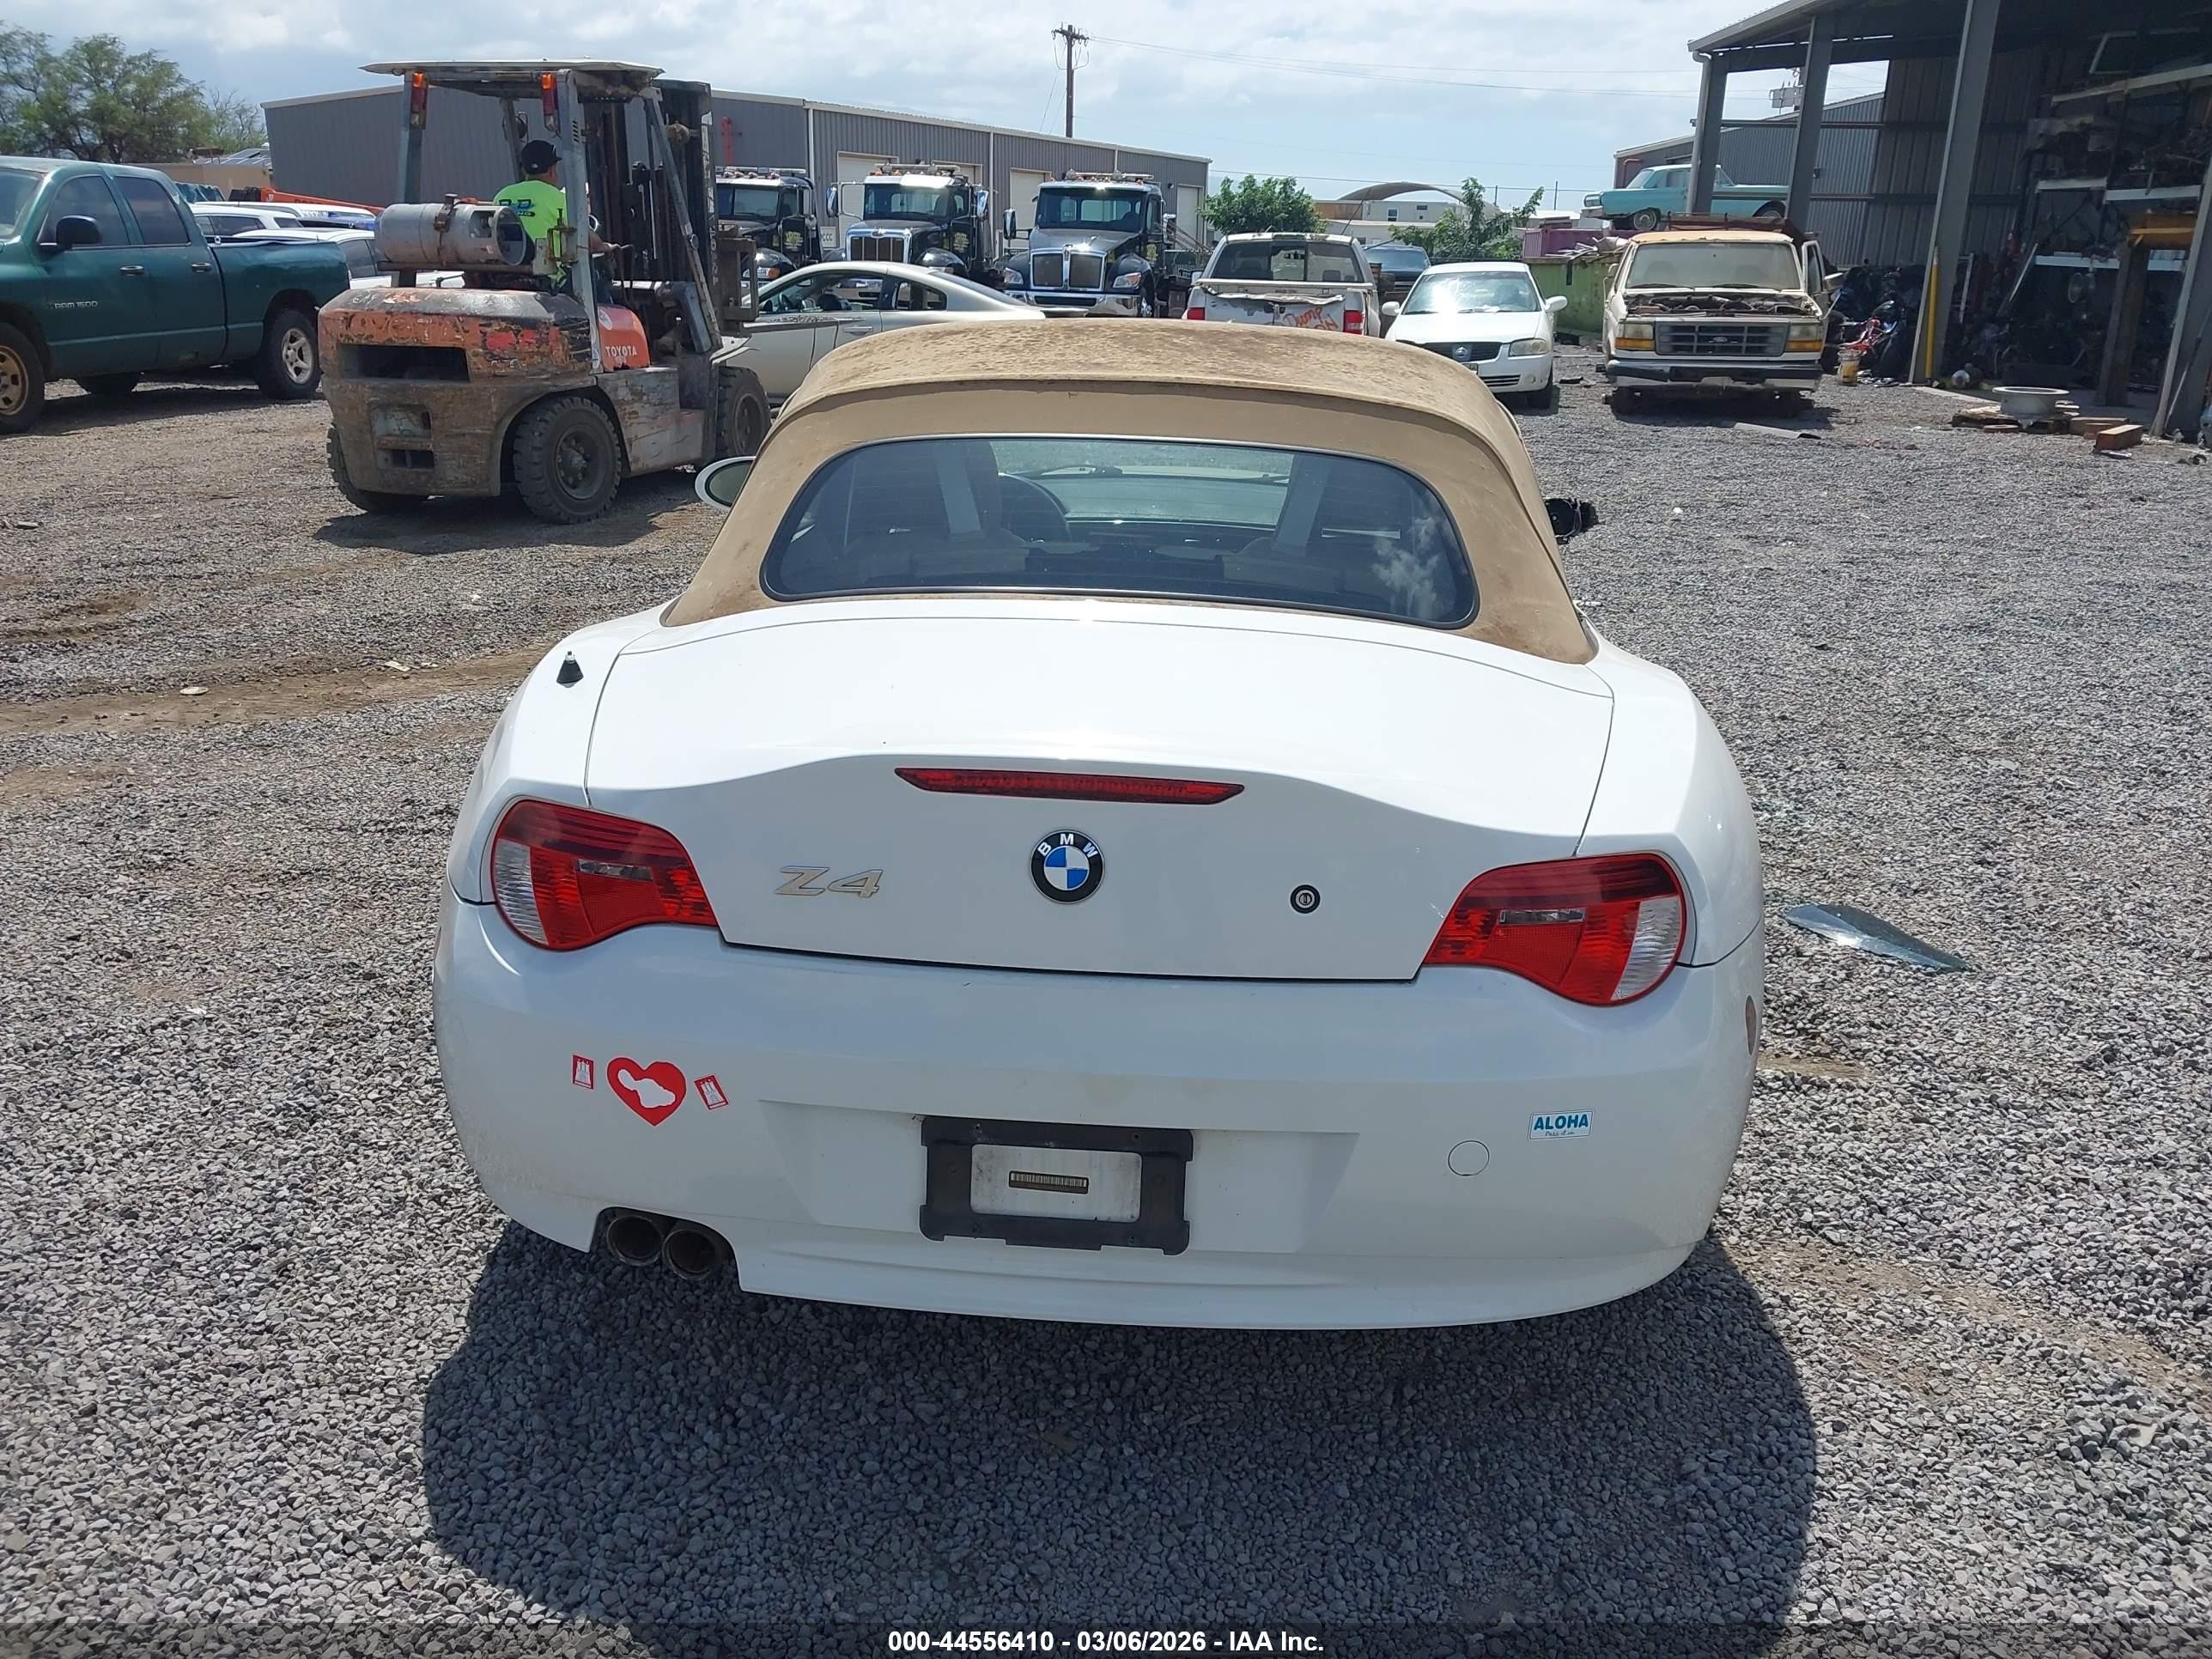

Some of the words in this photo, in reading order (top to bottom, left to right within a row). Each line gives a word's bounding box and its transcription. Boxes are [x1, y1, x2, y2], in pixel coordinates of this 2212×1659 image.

[605, 345, 638, 357] TOYOTA
[1036, 832, 1098, 858] BMW
[774, 865, 884, 899] Z4
[1534, 1115, 1589, 1130] ALOHA
